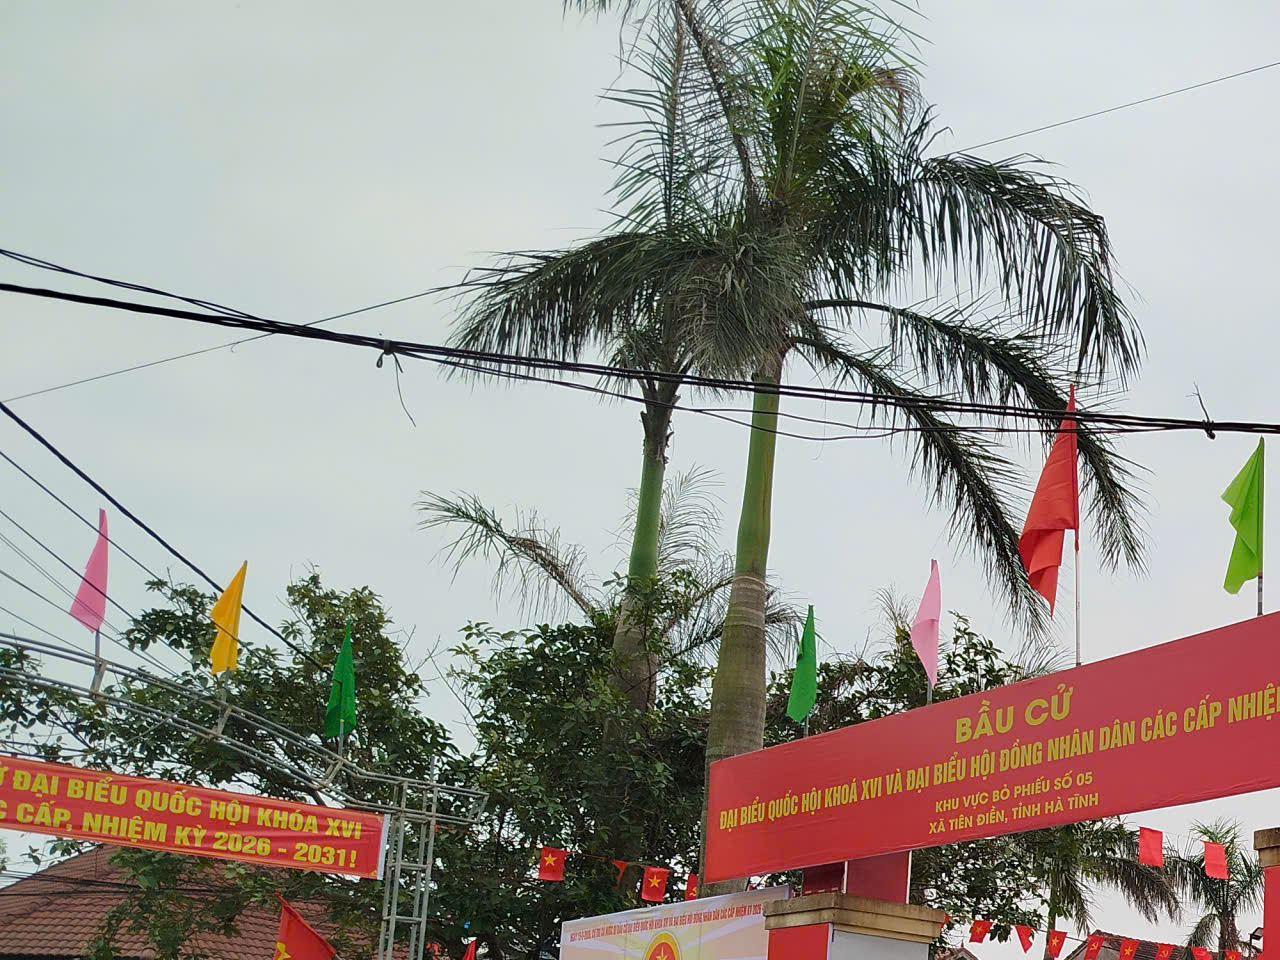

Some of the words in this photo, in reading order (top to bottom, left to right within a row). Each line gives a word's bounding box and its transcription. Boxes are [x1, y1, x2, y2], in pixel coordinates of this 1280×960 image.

[955, 700, 1014, 743] BẦU
[1024, 683, 1074, 726] CỬ
[720, 808, 738, 832] ĐẠI
[740, 795, 765, 826] BIỂU
[768, 789, 799, 821] QUỐC
[801, 787, 821, 815] HỘI
[824, 778, 858, 808] KHOÁ
[861, 776, 882, 800] XVI
[885, 768, 902, 795] VÀ
[906, 766, 930, 793] ĐẠI
[933, 751, 966, 785] BIỂU
[970, 748, 995, 780] HỘI
[1000, 738, 1043, 773] ĐỒNG
[1047, 727, 1094, 762] NHÂN
[1099, 719, 1135, 751] DÂN
[1140, 708, 1178, 742] CÁC
[1183, 694, 1222, 732] CẤP
[935, 797, 959, 813] KHU
[962, 791, 989, 809] VỰC
[992, 784, 1010, 802] BỎ
[1013, 776, 1050, 798] PHIẾU
[1054, 770, 1074, 790] SỐ
[1076, 772, 1094, 786] 05
[13, 770, 59, 797] ĐẠI
[67, 775, 127, 805] BIỂU
[135, 789, 202, 816] QUỐC
[209, 800, 250, 826] HỘI
[257, 808, 319, 834] KHÓA
[325, 818, 362, 840] XVI
[16, 801, 72, 832] CẤP,
[82, 812, 167, 843] NHIỆM
[174, 824, 208, 847] KỲ
[213, 831, 271, 856] 2026
[928, 820, 946, 835] XÃ
[949, 814, 973, 831] TIÊN
[976, 806, 1008, 826] ĐIỀN,
[1011, 802, 1040, 819] TỈNH
[1044, 796, 1064, 815] HÀ
[1068, 792, 1099, 810] TĨNH
